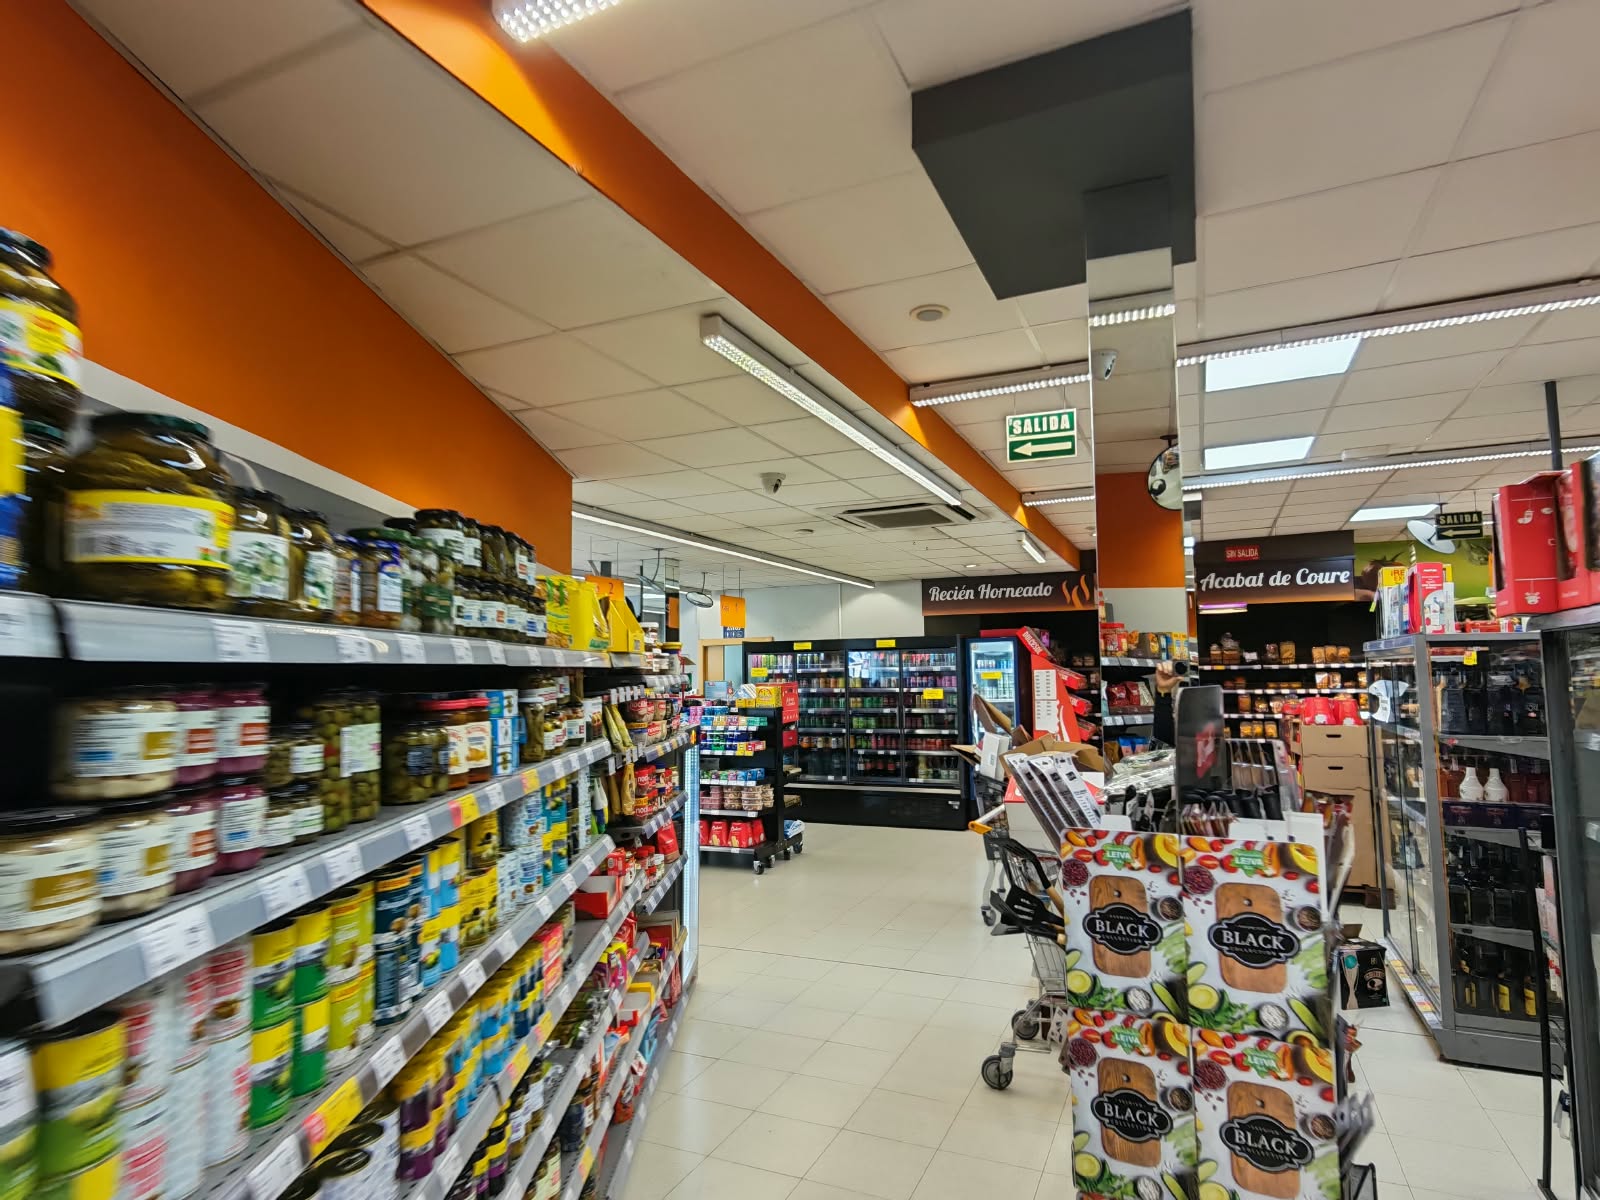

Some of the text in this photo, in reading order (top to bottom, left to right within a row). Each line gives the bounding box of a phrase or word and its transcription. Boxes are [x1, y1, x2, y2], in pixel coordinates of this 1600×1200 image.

[1012, 414, 1070, 435] SALIDA
[1439, 513, 1479, 525] SALIDA
[1237, 548, 1259, 558] SALIDA
[1200, 568, 1350, 592] Acabat de Coure
[929, 582, 1053, 602] Recién Horneado
[1107, 850, 1132, 860] LEIVA
[1236, 856, 1264, 866] LEIVA
[1095, 919, 1150, 939] BLACK
[1221, 930, 1286, 951] BLACK
[1115, 1032, 1141, 1044] LEIVA
[1104, 1102, 1159, 1128] BLACK
[1234, 1128, 1299, 1157] BLACK
